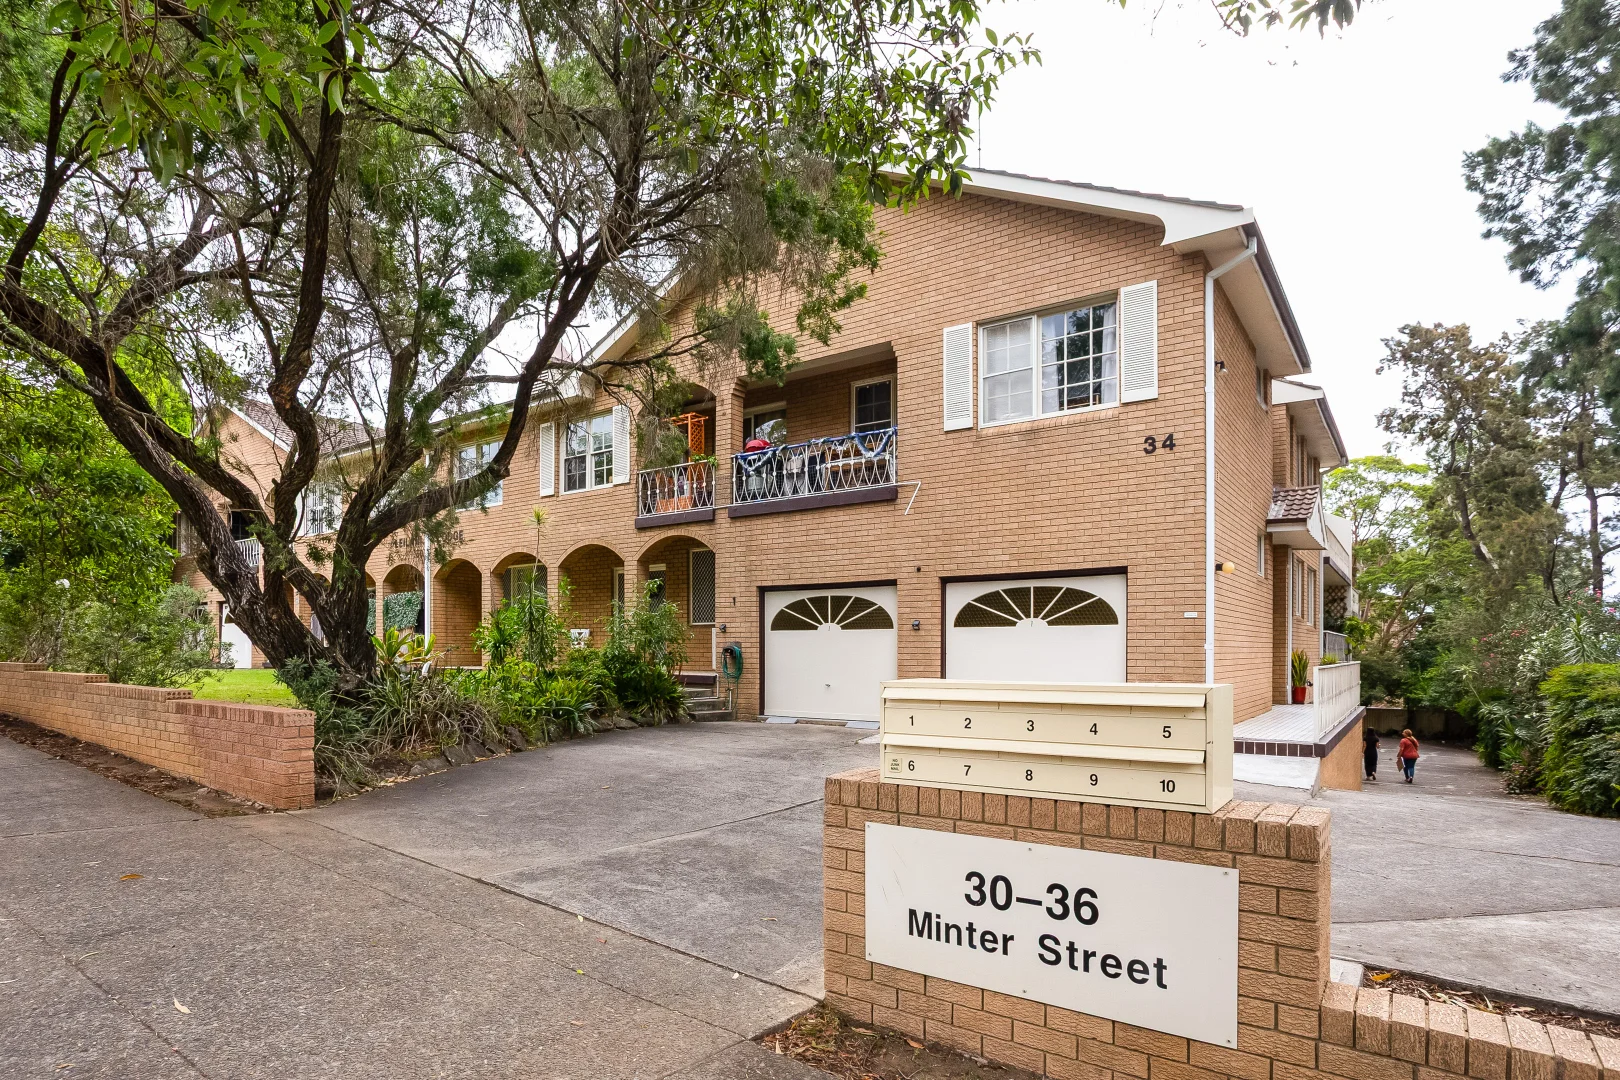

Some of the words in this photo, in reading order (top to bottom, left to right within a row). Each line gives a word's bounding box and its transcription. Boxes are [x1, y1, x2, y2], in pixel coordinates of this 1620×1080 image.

[1143, 433, 1176, 454] 34
[908, 715, 914, 727] 1
[964, 717, 972, 730] 2
[1026, 719, 1035, 732] 3
[1089, 722, 1098, 736] 4
[1162, 725, 1172, 739] 5
[908, 759, 915, 772] 6
[963, 764, 971, 777] 7
[1025, 769, 1034, 782] 8
[1089, 773, 1099, 787] 9
[1159, 779, 1176, 793] 10
[908, 908, 1015, 956] Minter
[1037, 933, 1168, 990] Street
